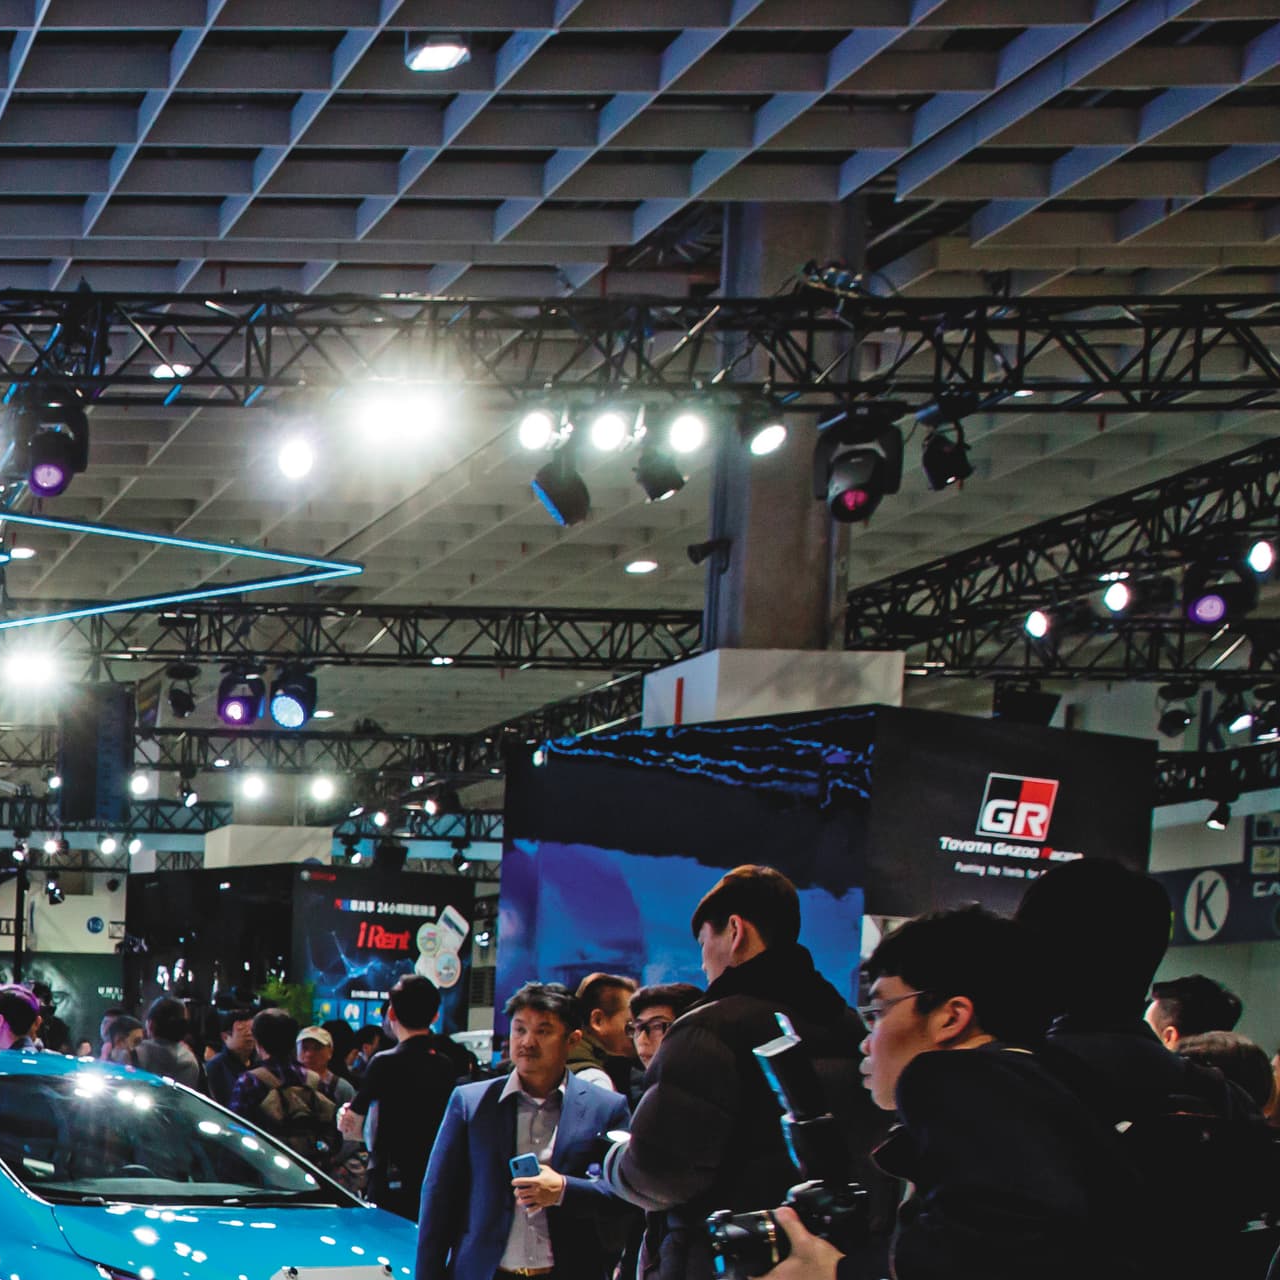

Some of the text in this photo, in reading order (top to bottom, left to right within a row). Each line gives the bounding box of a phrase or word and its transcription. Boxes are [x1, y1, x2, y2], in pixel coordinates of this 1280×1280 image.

[981, 799, 1049, 837] GR
[939, 836, 991, 855] TOYOTA
[1193, 879, 1221, 931] K
